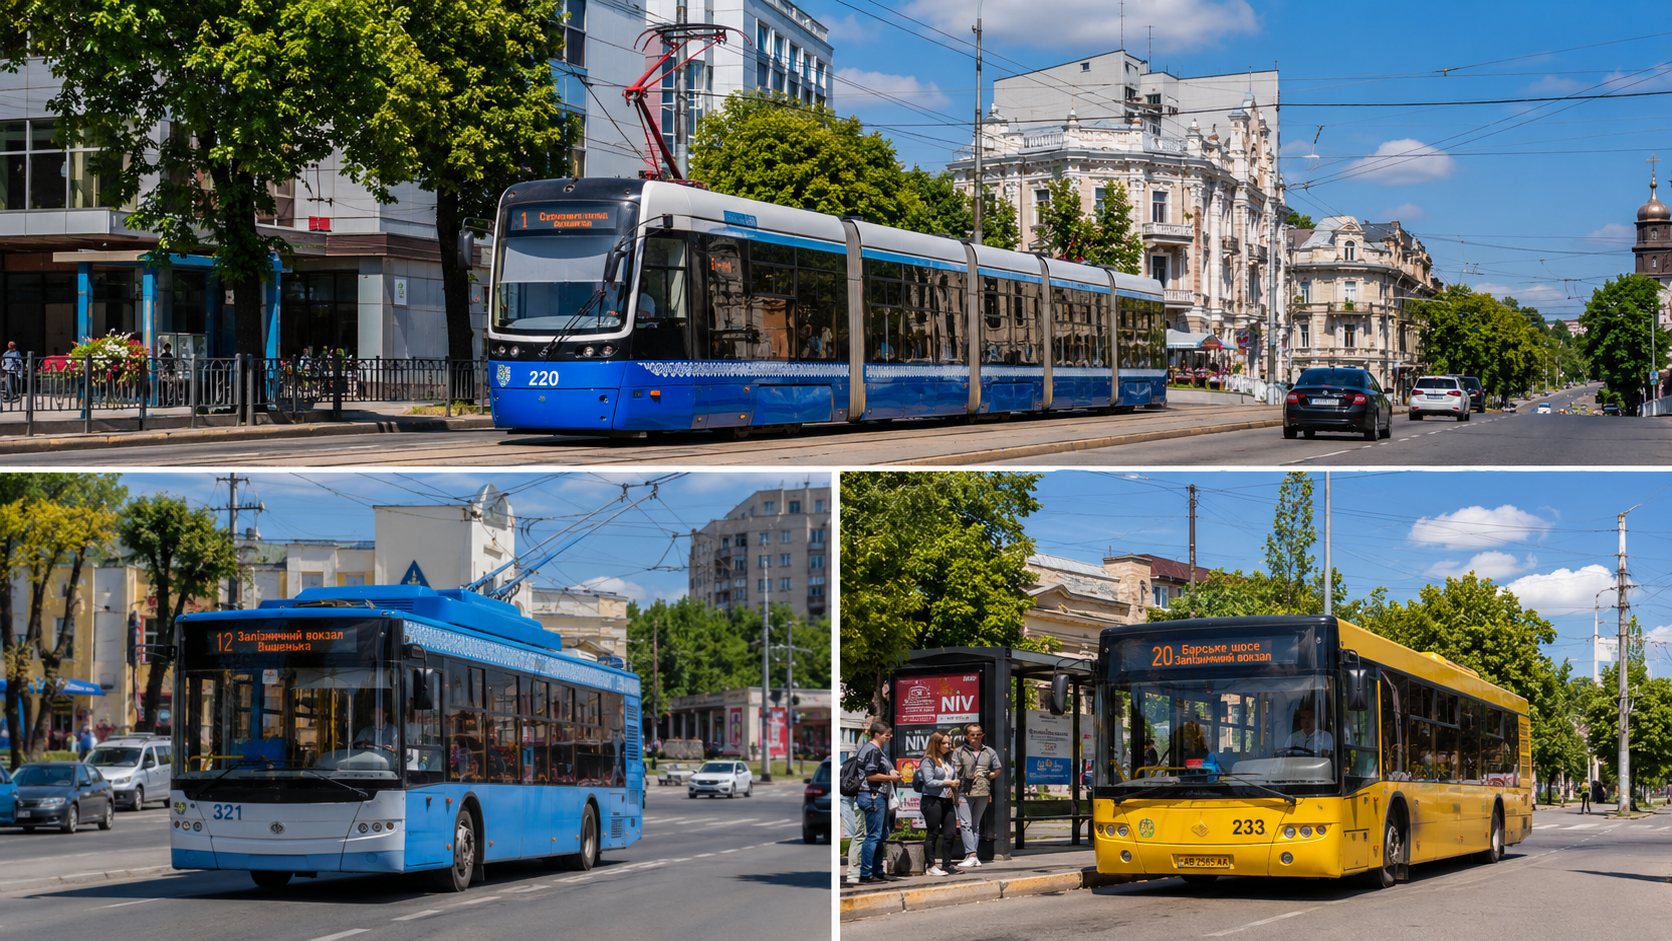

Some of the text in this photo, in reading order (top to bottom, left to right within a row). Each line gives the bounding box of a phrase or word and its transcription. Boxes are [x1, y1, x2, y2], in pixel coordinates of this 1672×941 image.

[521, 211, 528, 229] 1
[529, 370, 559, 386] 220
[216, 632, 233, 652] 12
[306, 631, 344, 641] вокзал
[258, 641, 312, 652] Вишенька
[1231, 642, 1260, 652] шосе
[1152, 645, 1173, 667] 20
[1237, 652, 1272, 662] вокзал
[213, 803, 242, 821] 321
[1232, 819, 1265, 835] 233
